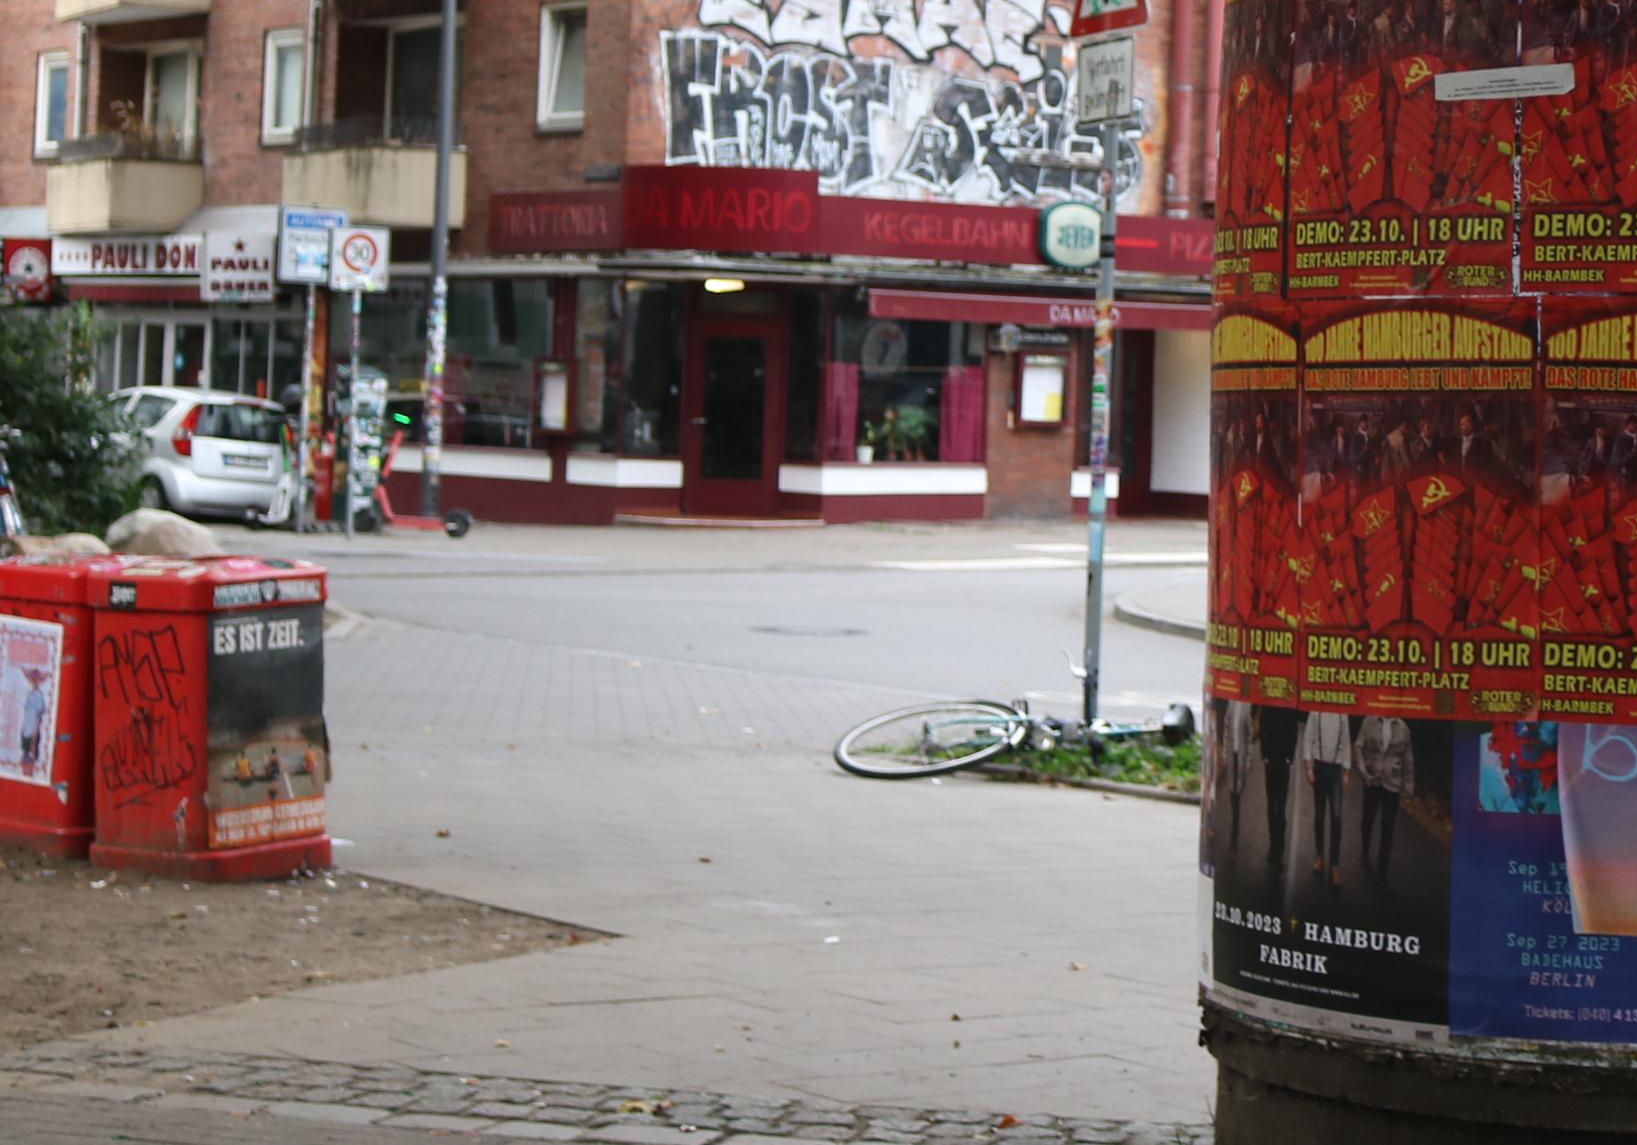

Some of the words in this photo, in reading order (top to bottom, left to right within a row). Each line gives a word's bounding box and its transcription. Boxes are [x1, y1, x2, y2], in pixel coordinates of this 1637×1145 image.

[624, 187, 668, 230] DA
[679, 186, 814, 233] MARIO
[864, 212, 1030, 249] KEGELBAHN
[1533, 213, 1612, 238] DEMO:
[1295, 221, 1345, 246] DEMO:
[1348, 218, 1405, 243] 23.10.
[1457, 217, 1505, 242] UHR
[91, 242, 148, 270] PAULI
[210, 257, 270, 271] PAULI
[1523, 269, 1604, 282] HH-BARMBEK
[1050, 304, 1071, 323] DA
[1545, 328, 1577, 359] 100
[1579, 315, 1632, 360] JAHRE
[1545, 366, 1577, 389] DAS
[1577, 367, 1617, 389] ROTE
[213, 624, 237, 656] ES
[240, 621, 264, 654] IST
[267, 617, 305, 650] ZEIT.
[1264, 630, 1293, 655] UHR
[1307, 635, 1363, 661] DEMO:
[1367, 638, 1427, 663] 23.10.
[1451, 641, 1474, 665] 18
[1481, 642, 1531, 667] UHR
[1543, 642, 1623, 669] DEMO:
[1307, 666, 1470, 690] BERT-KAEMPFERT-PLATZ
[1481, 690, 1522, 703] ROTER
[1508, 860, 1538, 877] Sep
[1304, 921, 1421, 955] HAMBURG
[1507, 932, 1537, 949] Sep
[1548, 934, 1567, 949] 27
[1578, 937, 1620, 952] 2023
[1259, 943, 1328, 974] FABRIK
[1520, 953, 1604, 970] BADEHAUS
[1529, 972, 1596, 988] BERLIN
[1523, 1005, 1575, 1021] Tickets:
